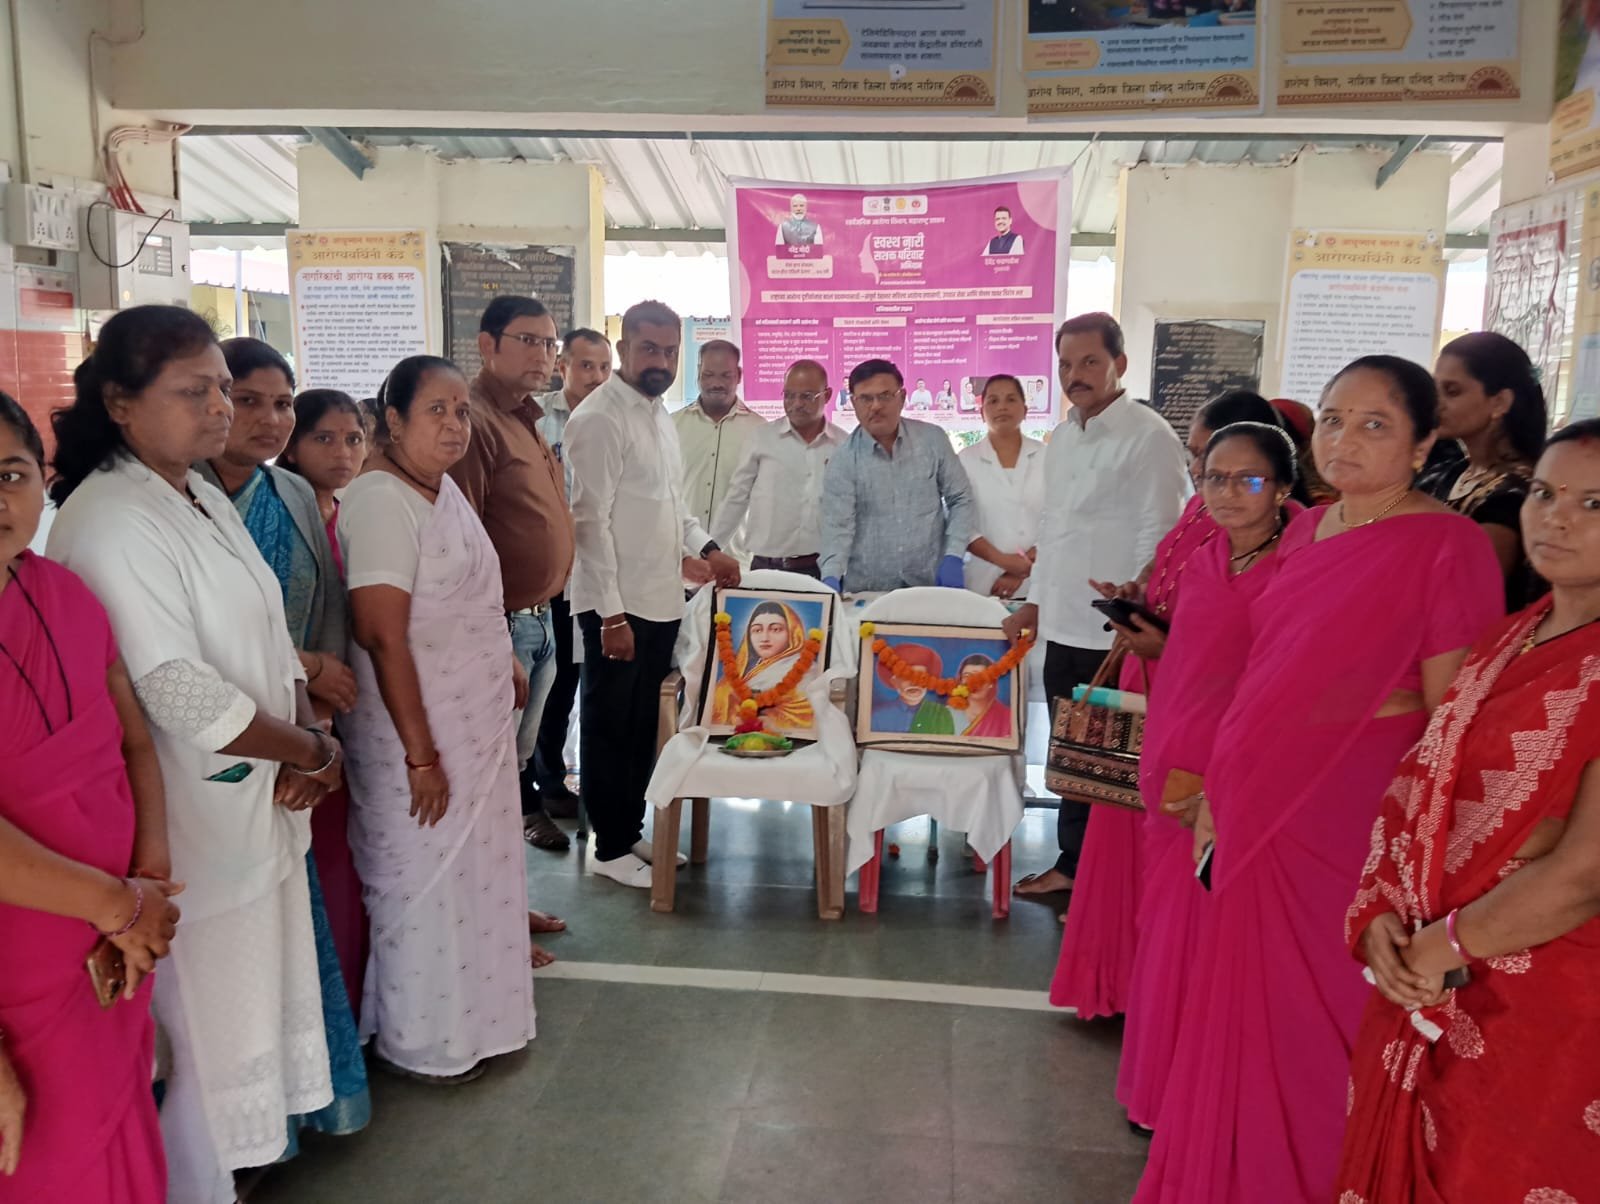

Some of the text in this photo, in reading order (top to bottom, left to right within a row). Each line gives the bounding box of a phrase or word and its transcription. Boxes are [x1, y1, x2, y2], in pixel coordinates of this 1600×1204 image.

[772, 78, 945, 92] आरोग्य विभाग, नाशिक जिल्हा परिषद नाशिक
[1313, 74, 1341, 88] विभाग,
[1348, 73, 1376, 86] नाशिक
[1381, 73, 1405, 86] जिल्हा
[1409, 72, 1433, 87] परिषद
[1438, 71, 1466, 84] नाशिक
[1056, 84, 1083, 97] विभाग,
[1089, 82, 1117, 95] नाशिक
[1122, 81, 1145, 94] जिल्हा
[1149, 80, 1173, 95] परिषद
[1177, 79, 1206, 92] नाशिक
[873, 231, 925, 249] स्वस्थ नारी
[311, 248, 405, 260] आरोग्यवर्धिनी केंद्र
[898, 247, 925, 261] परिवार
[1314, 251, 1394, 264] आरोग्यवर्धिनी
[302, 269, 415, 281] नागरिकांची आरोग्य हक्क सनद
